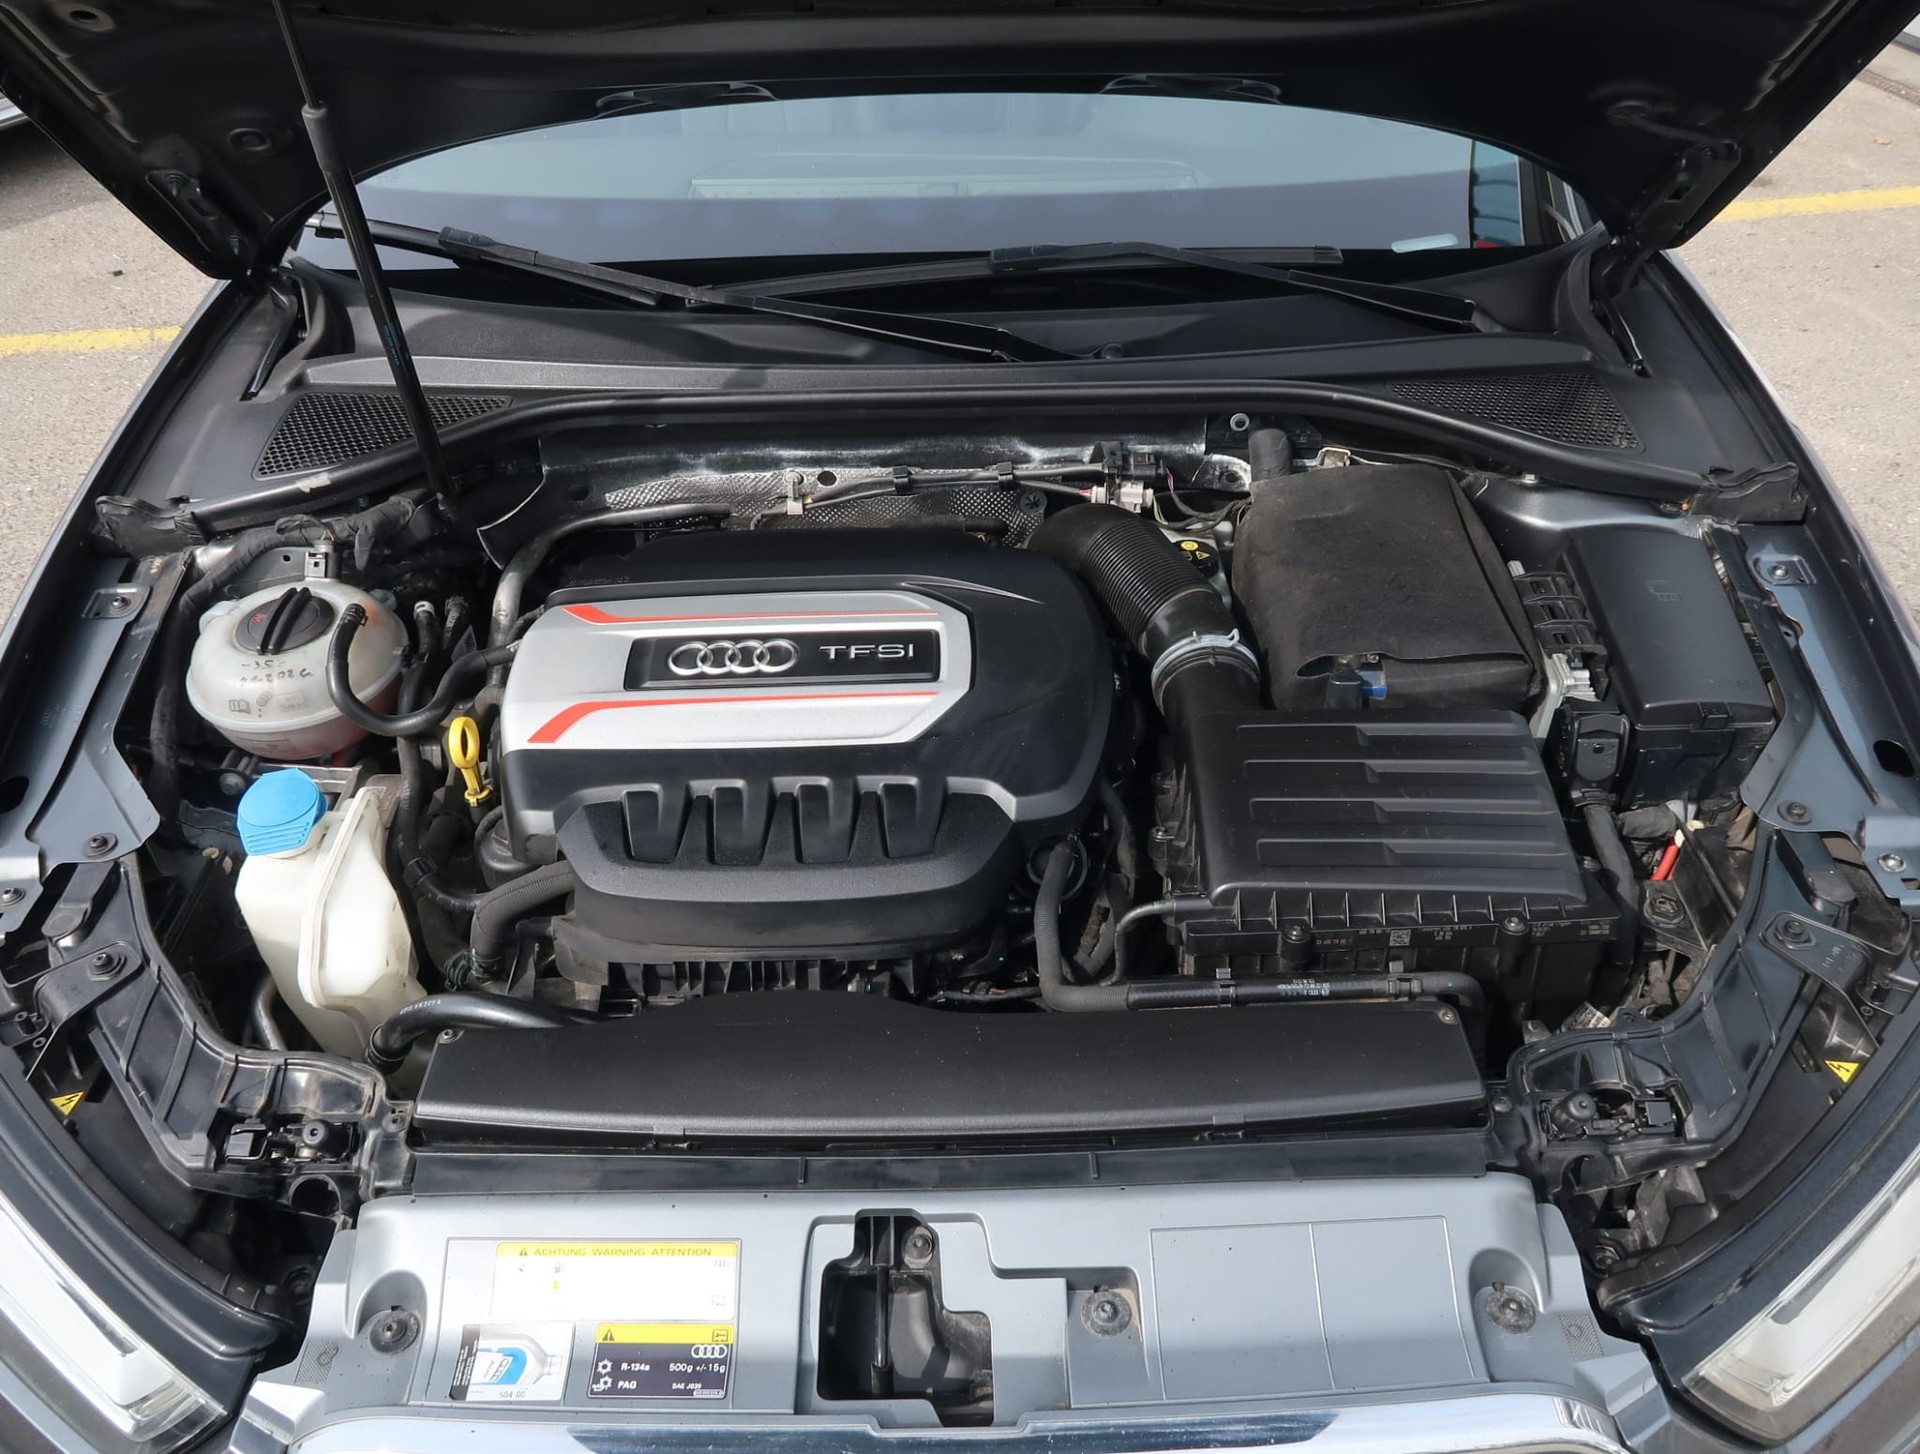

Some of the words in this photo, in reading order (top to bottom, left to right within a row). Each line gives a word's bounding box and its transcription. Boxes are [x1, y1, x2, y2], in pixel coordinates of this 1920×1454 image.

[819, 643, 914, 660] TFSI
[534, 1248, 586, 1257] ACHTUNG
[592, 1248, 645, 1257] WARNING
[651, 1248, 712, 1257] ATTENTION
[621, 1362, 650, 1371] R-134a
[669, 1362, 694, 1373] 500g
[617, 1381, 638, 1389] PAG
